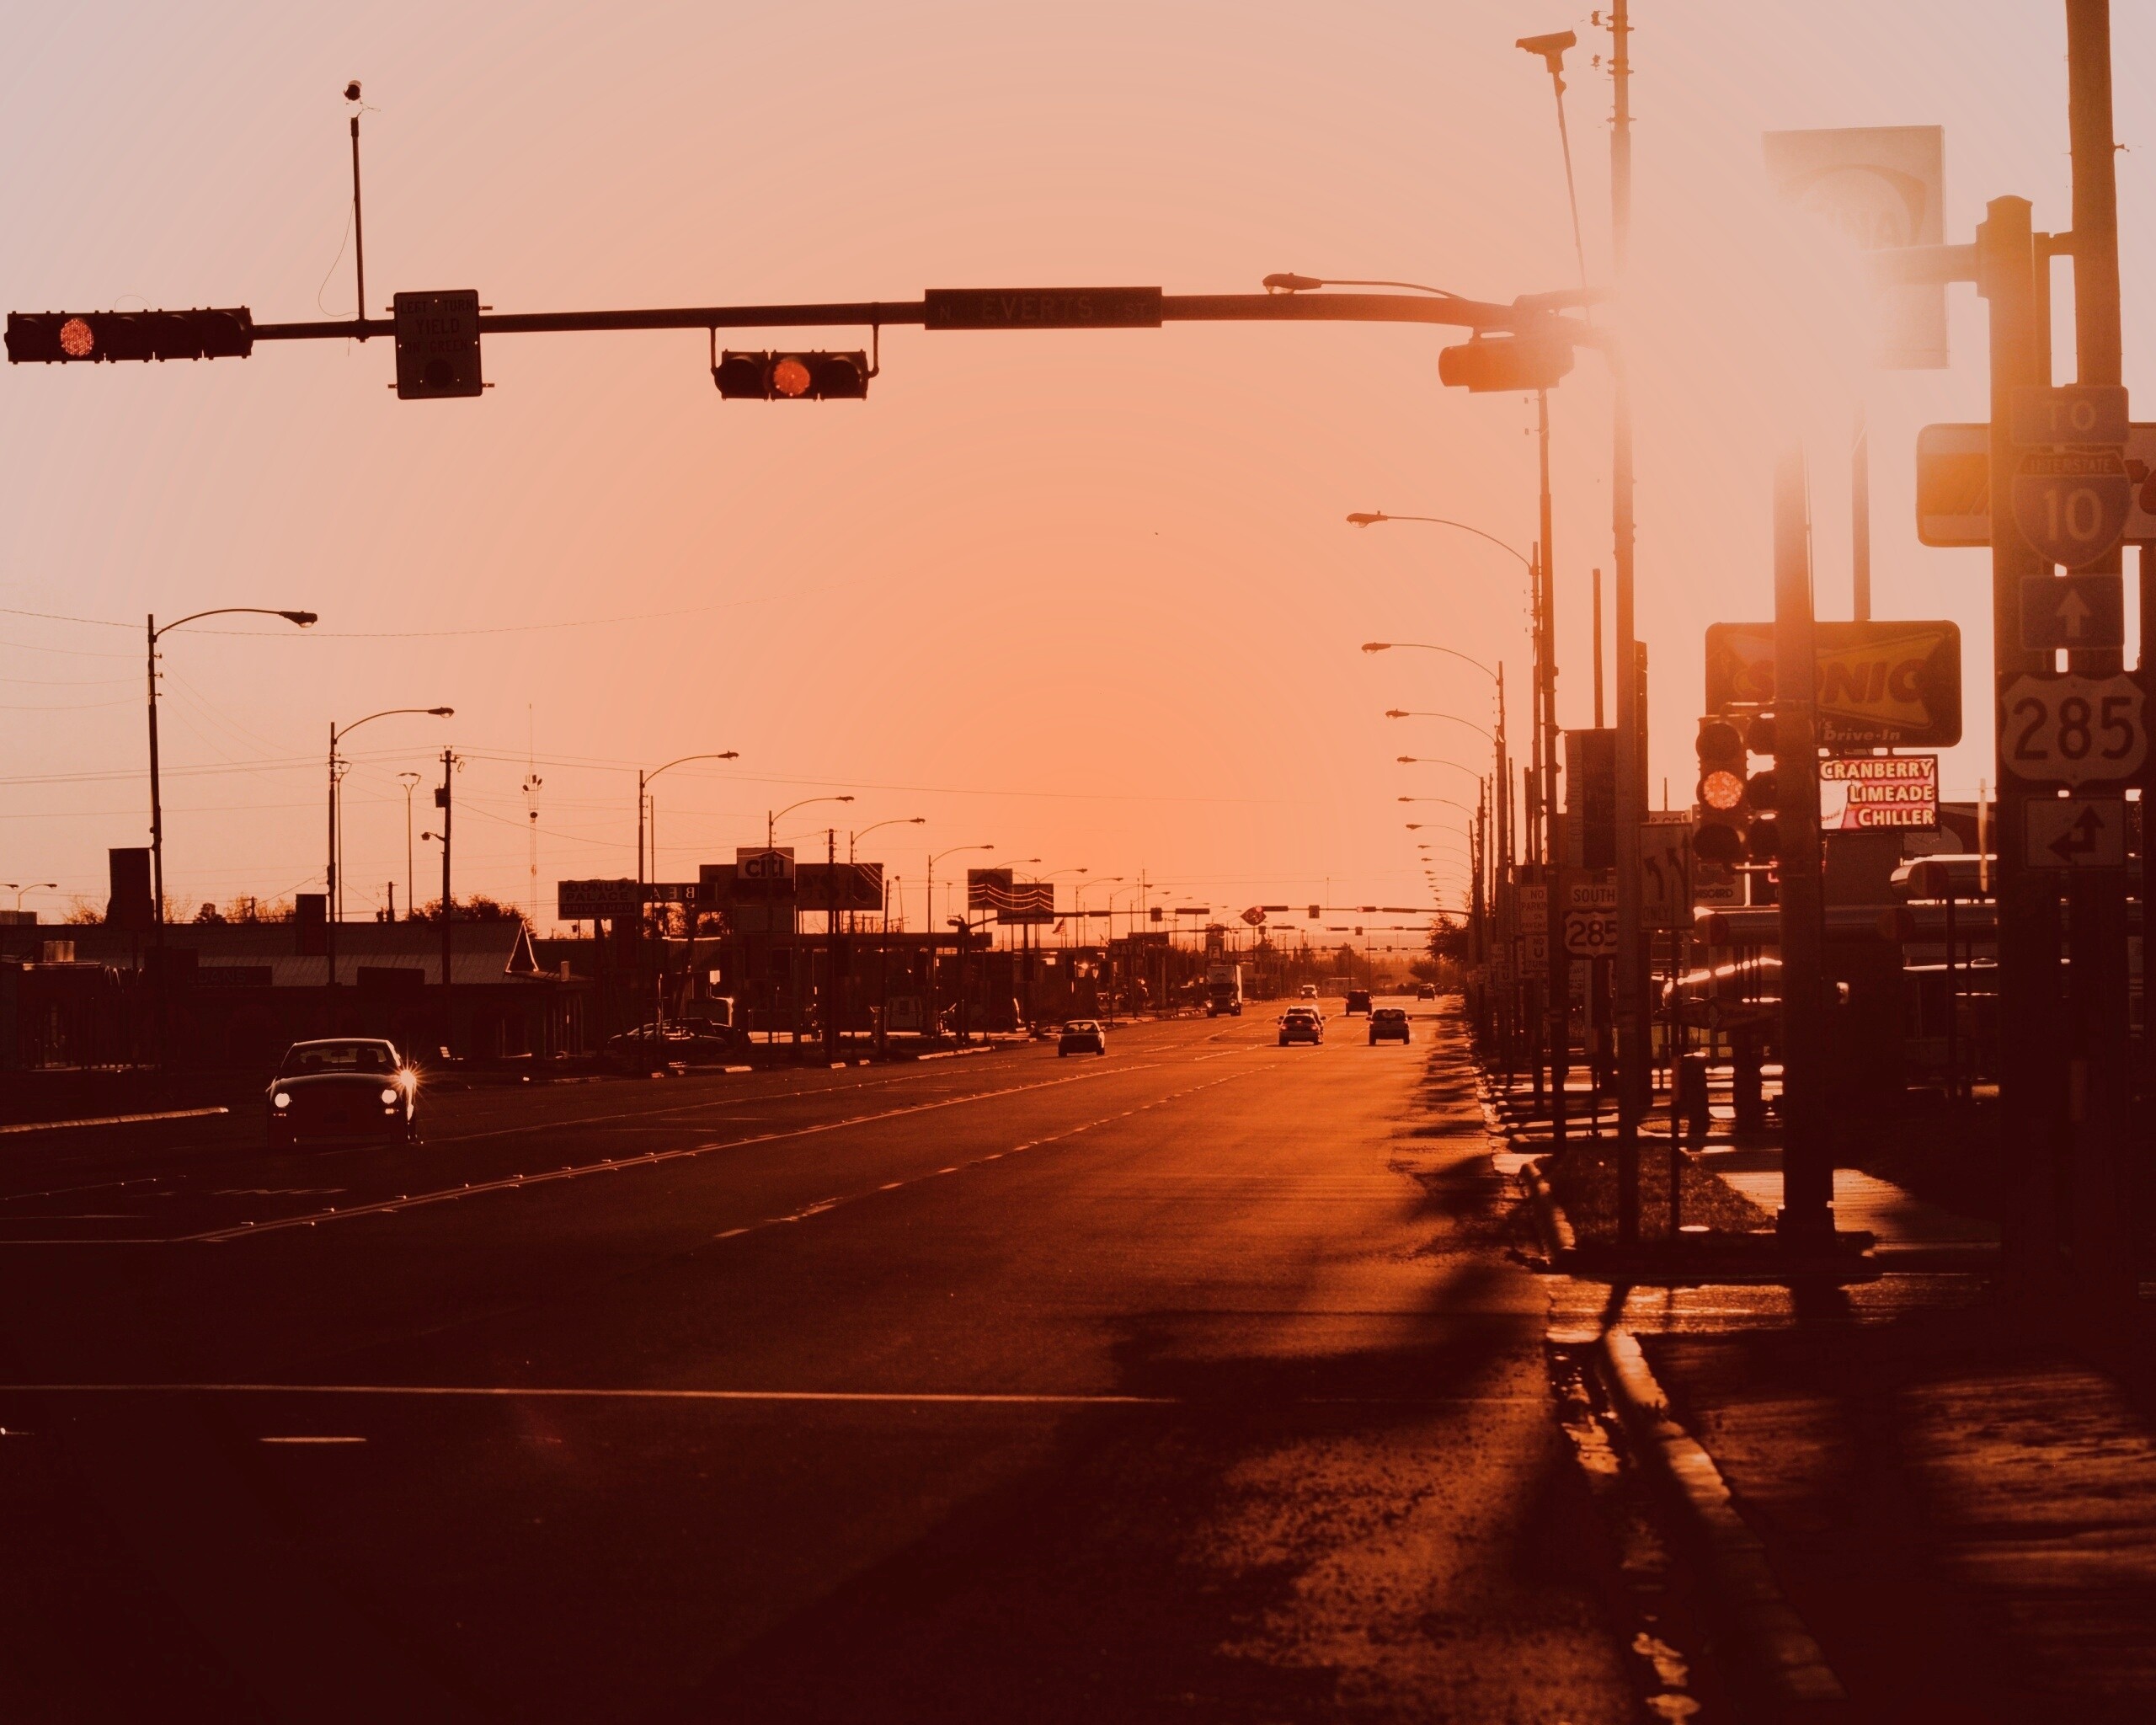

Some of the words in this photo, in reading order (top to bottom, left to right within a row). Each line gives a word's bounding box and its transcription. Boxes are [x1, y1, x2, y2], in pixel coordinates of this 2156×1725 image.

[400, 301, 428, 314] LEFT
[443, 299, 473, 312] TURN
[939, 305, 951, 321] N
[981, 296, 1094, 320] EVERTS
[1124, 302, 1148, 319] ST
[416, 318, 460, 334] YIELD
[404, 340, 420, 354] ON
[430, 339, 467, 354] GREEN
[2041, 399, 2096, 431] TO
[2030, 458, 2111, 473] INTERSTATE
[2043, 488, 2102, 542] 10
[1745, 659, 1928, 704] SNIC
[2012, 696, 2135, 761] 285
[1820, 760, 1933, 779] CRANBERRY
[1849, 784, 1935, 803] LIMEADE
[1858, 808, 1935, 826] CHILLER
[745, 857, 783, 878] citi
[566, 892, 629, 902] PALACE
[1530, 889, 1545, 900] NO
[1573, 888, 1616, 903] SOUTH
[602, 904, 632, 912] THRU
[1521, 901, 1548, 911] PARKIN
[1642, 905, 1670, 921] ONLY
[1533, 937, 1545, 946] NO
[1568, 920, 1617, 947] 285
[1534, 948, 1544, 959] U
